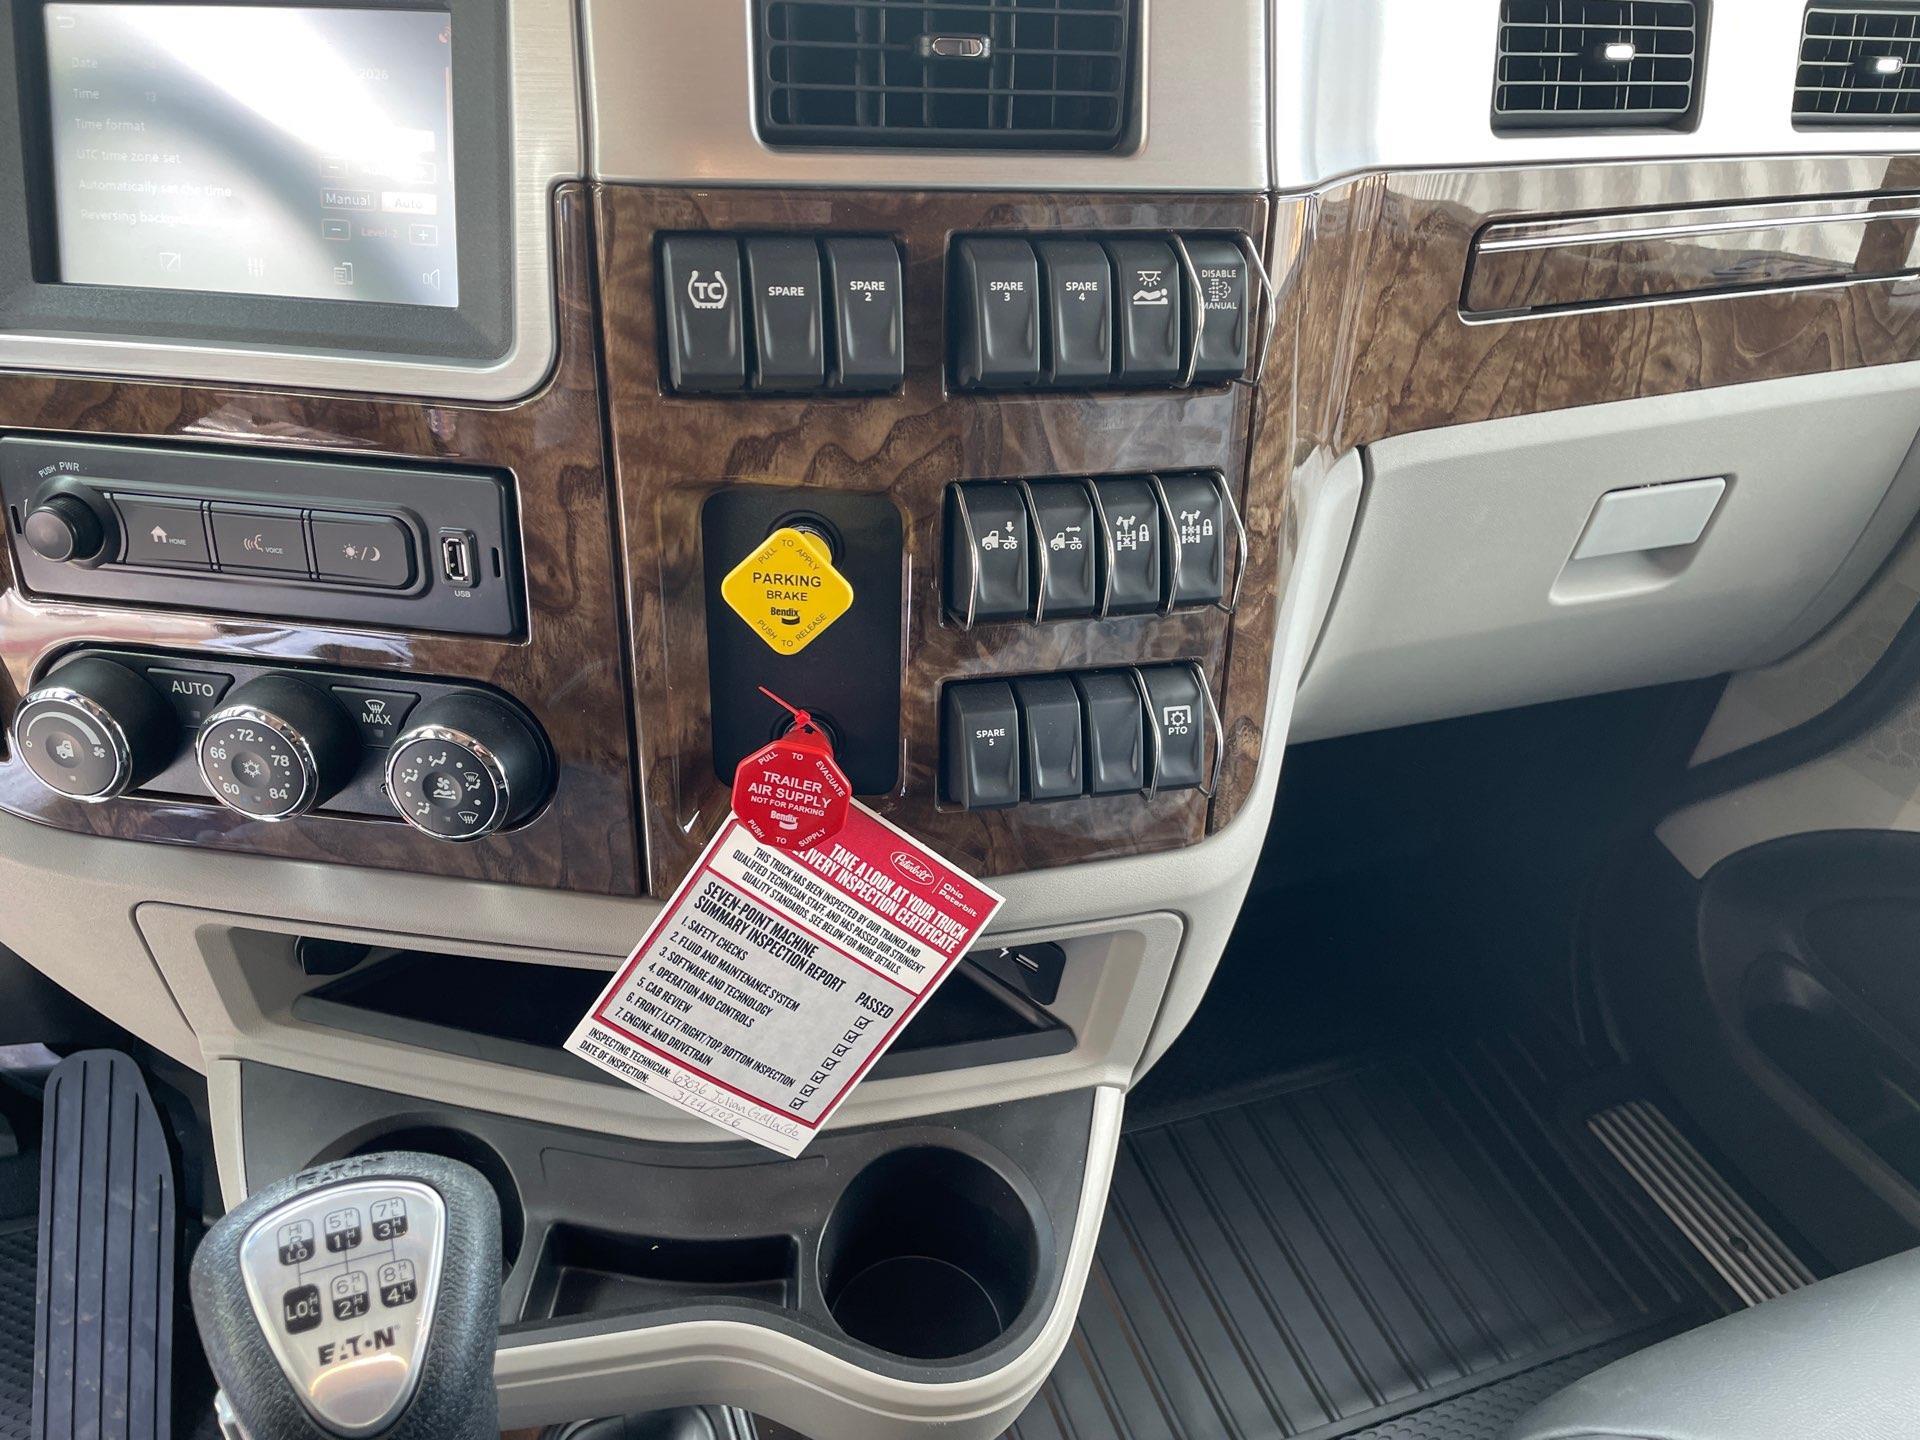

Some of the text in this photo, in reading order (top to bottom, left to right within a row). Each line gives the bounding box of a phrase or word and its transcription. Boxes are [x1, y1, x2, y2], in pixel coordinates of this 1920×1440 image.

[73, 88, 100, 99] Time
[75, 118, 145, 131] Time format
[325, 192, 371, 206] Manual
[394, 198, 423, 210] Auto
[81, 208, 137, 226] Reversing
[1201, 269, 1237, 278] DISABLE
[694, 281, 722, 300] TC
[768, 285, 805, 298] SPARE
[850, 280, 886, 293] SPARE
[989, 280, 1024, 292] SPARE
[1065, 280, 1099, 292] SPARE
[864, 292, 872, 302] 2
[1003, 292, 1011, 302] 3
[1077, 292, 1086, 302] 4
[1200, 301, 1238, 310] MANUAL
[38, 461, 80, 478] PUSH PWR
[168, 537, 187, 546] HOME
[264, 546, 284, 555] VOICE
[757, 539, 820, 571] PULL TO APPLY
[752, 572, 822, 588] PARKING
[454, 590, 471, 599] USB
[766, 589, 808, 602] BRAKE
[770, 606, 800, 618] Bendix
[756, 613, 828, 648] PUSH TO RELEASE
[171, 679, 215, 698] AUTO
[361, 711, 392, 727] MAX
[236, 728, 255, 742] 72
[975, 728, 1006, 739] SPARE
[1168, 726, 1188, 736] PTO
[988, 738, 995, 747] 5
[209, 747, 227, 760] 66
[271, 754, 290, 767] 78
[757, 751, 846, 798] PULL TO EVACUATE
[763, 770, 823, 794] TRAILER
[222, 782, 240, 795] 60
[268, 787, 288, 801] 84
[748, 782, 832, 809] AIR SUPPLY
[751, 795, 825, 817] NOT FOR PARKING
[770, 810, 799, 823] Bendix
[747, 819, 827, 847] PUSH TO SUPPLY
[895, 854, 930, 881] Peterbilt
[827, 843, 968, 941] TAKE A LOOK AT YOUR TRUCK
[943, 882, 964, 899] Ohio
[752, 847, 921, 957] THIS TRUCK HAS BEEN INSPECTED BY OUR TRAINED AND
[791, 848, 959, 953] LIVERY INSPECTION CERTIFICATE
[938, 889, 978, 917] Peterbilt
[703, 880, 820, 958] SEVEN-POINT MACHINE
[732, 849, 925, 974] QUALIFIED TECHNICIAN STAFF, AND HAS PASSED OUR STRINGENT
[742, 871, 903, 975] QUALITY STANDARDS. SEE BELOW FOR MORE DETAILS.
[681, 916, 749, 961] 1. SAFETY CHECKS
[693, 894, 846, 992] SUMMARY INSPECTION REPORT
[669, 931, 801, 1011] 2. FLUID AND MAINTENANCE SYSTEM
[658, 946, 773, 1017] 3. SOFTWARE AND TECHNOLOGY
[637, 976, 693, 1013] 5. CAB REVIEW
[647, 961, 755, 1028] 4. OPERATION AND CONTROLS
[855, 991, 895, 1019] PASSED
[615, 1006, 713, 1066] 7. ENGINE AND DRIVETRAIN
[626, 991, 796, 1088] 6. FRONT/LEFT/RIGHT/TOP/BOTTOM INSPECTION
[588, 1027, 672, 1077] INSPECTING TECHNICIAN:
[579, 1040, 650, 1083] DATE OF INSPECTION:
[376, 1204, 387, 1217] 7
[330, 1216, 341, 1228] 5
[379, 1223, 391, 1237] 3
[334, 1236, 341, 1248] 1
[287, 1249, 307, 1263] LO
[384, 1267, 396, 1282] 8
[336, 1280, 349, 1294] 6
[388, 1288, 400, 1302] 4
[286, 1302, 307, 1320] LO
[339, 1302, 351, 1318] 2
